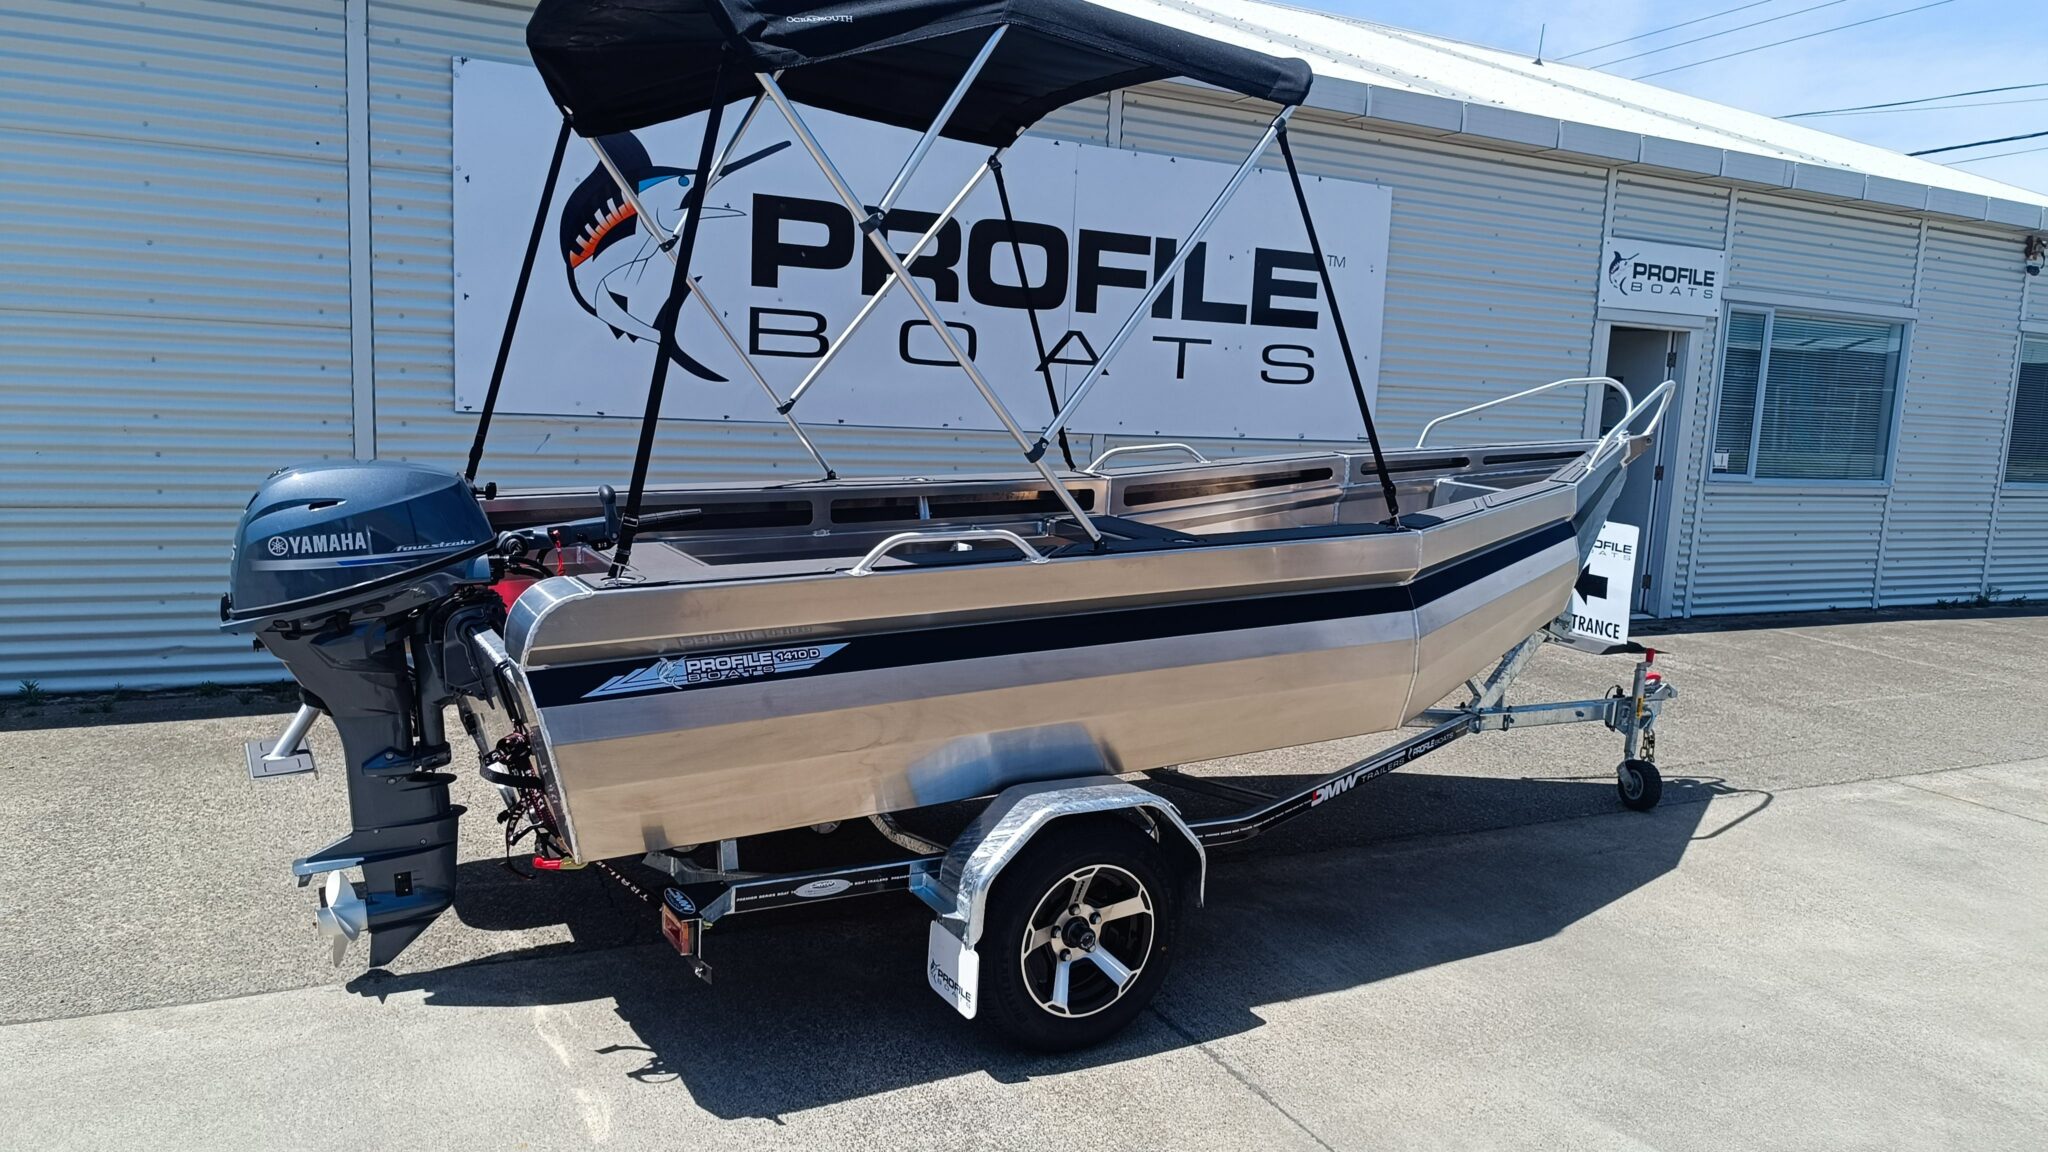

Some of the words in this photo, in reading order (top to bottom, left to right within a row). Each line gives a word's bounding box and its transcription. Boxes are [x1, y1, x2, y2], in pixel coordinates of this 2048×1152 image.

[751, 193, 1319, 329] PROFILE
[1632, 262, 1715, 287] PROFILE
[1631, 282, 1714, 300] BOATS
[749, 306, 1315, 385] BOATS
[288, 531, 367, 555] YAMAHA
[1594, 540, 1632, 555] OFILE
[1572, 613, 1620, 640] TRANCE
[687, 653, 774, 673] PROFILE
[687, 665, 774, 682] BOATS
[1311, 773, 1360, 806] DMW
[1361, 757, 1405, 783] TRAILERS
[938, 969, 972, 1002] PROFILE
